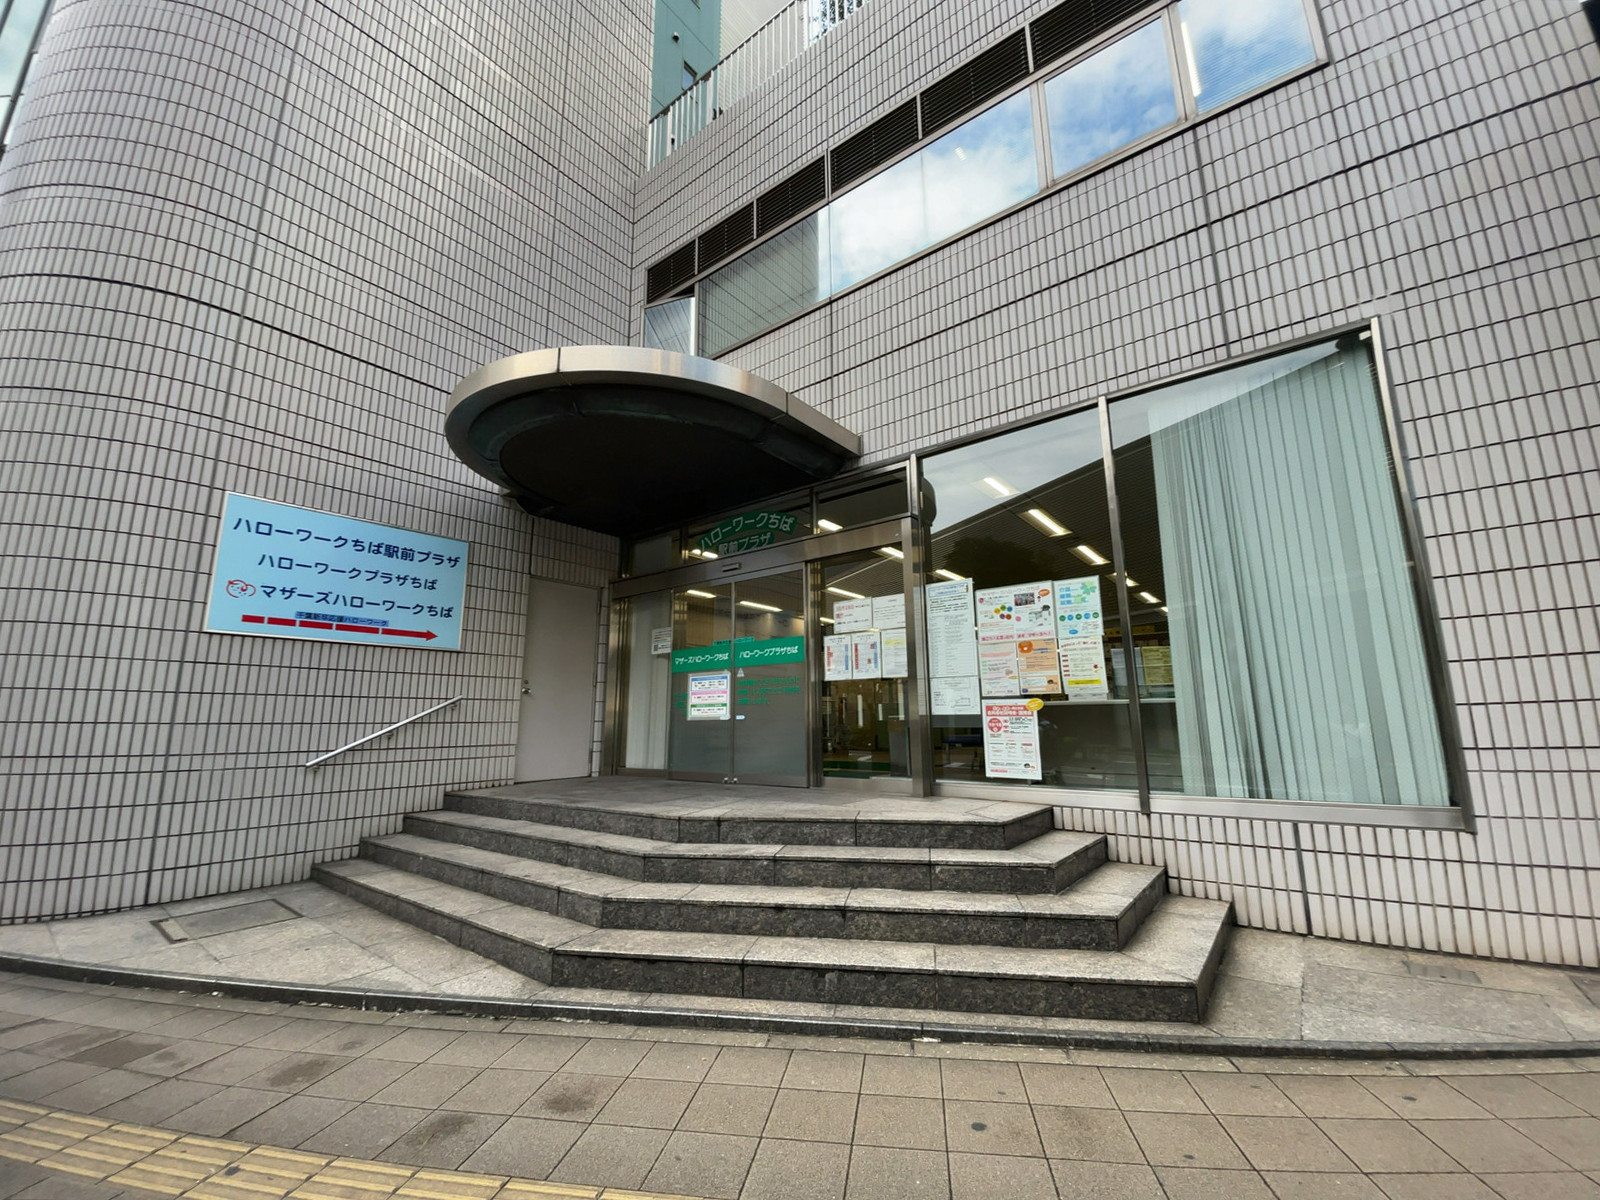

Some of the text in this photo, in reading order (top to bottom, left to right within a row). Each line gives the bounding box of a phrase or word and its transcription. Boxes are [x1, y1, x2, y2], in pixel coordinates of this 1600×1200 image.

[233, 517, 461, 569] ハローワークちば駅前プラザ
[700, 513, 795, 552] ハローワークちば
[718, 532, 771, 555] 駅前プラザ
[258, 553, 438, 591] ハローワークプラザちば
[260, 583, 454, 618] マザーズハローワークちば
[675, 652, 729, 665] マザーズハローワークちば
[739, 645, 799, 658] ハローワークプラザちば
